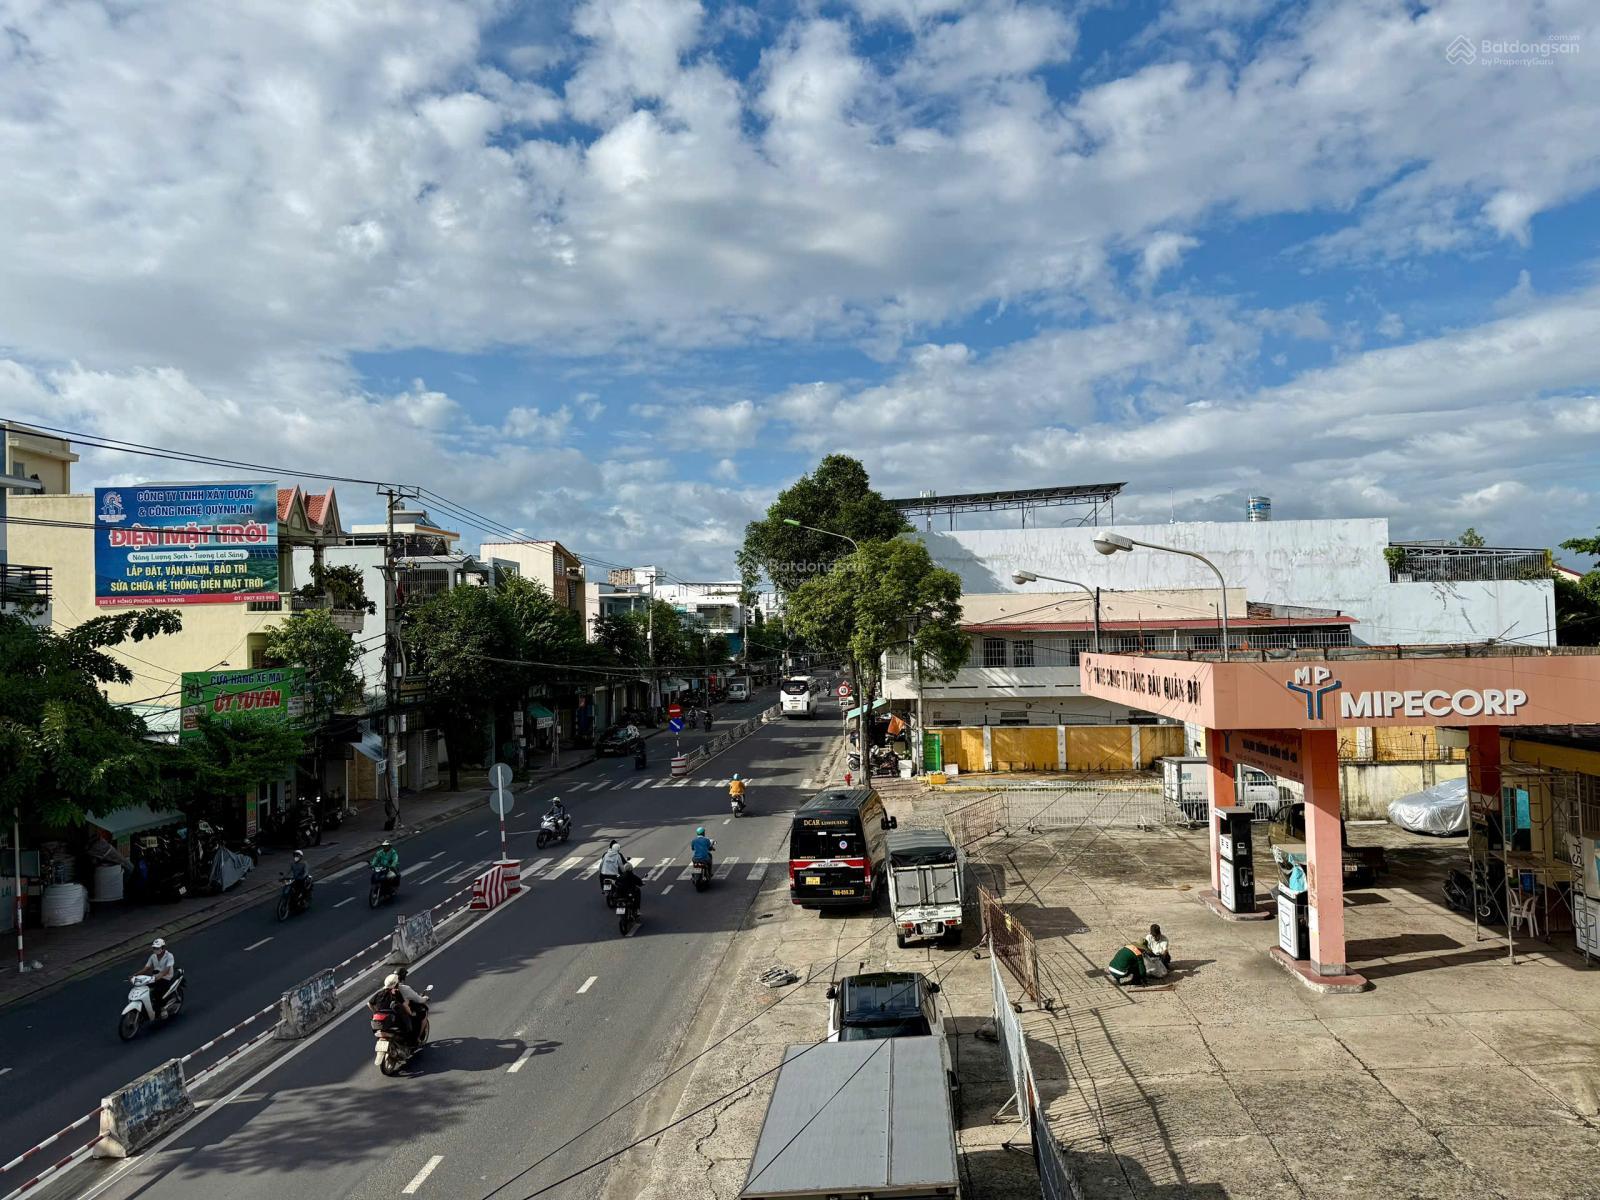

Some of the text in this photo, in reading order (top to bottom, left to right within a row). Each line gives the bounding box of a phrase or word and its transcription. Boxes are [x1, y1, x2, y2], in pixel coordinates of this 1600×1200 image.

[137, 490, 164, 502] CÔNG
[165, 490, 177, 501] TY
[179, 490, 204, 501] TNHH
[206, 488, 226, 500] XÂY
[138, 503, 253, 518] & CÔNG NGHỆ QUỲNH AN
[109, 520, 268, 551] ĐIỆN MẶT TRỜI
[256, 671, 267, 683] XE
[1294, 666, 1330, 685] MP
[1340, 688, 1528, 719] MIPECORP
